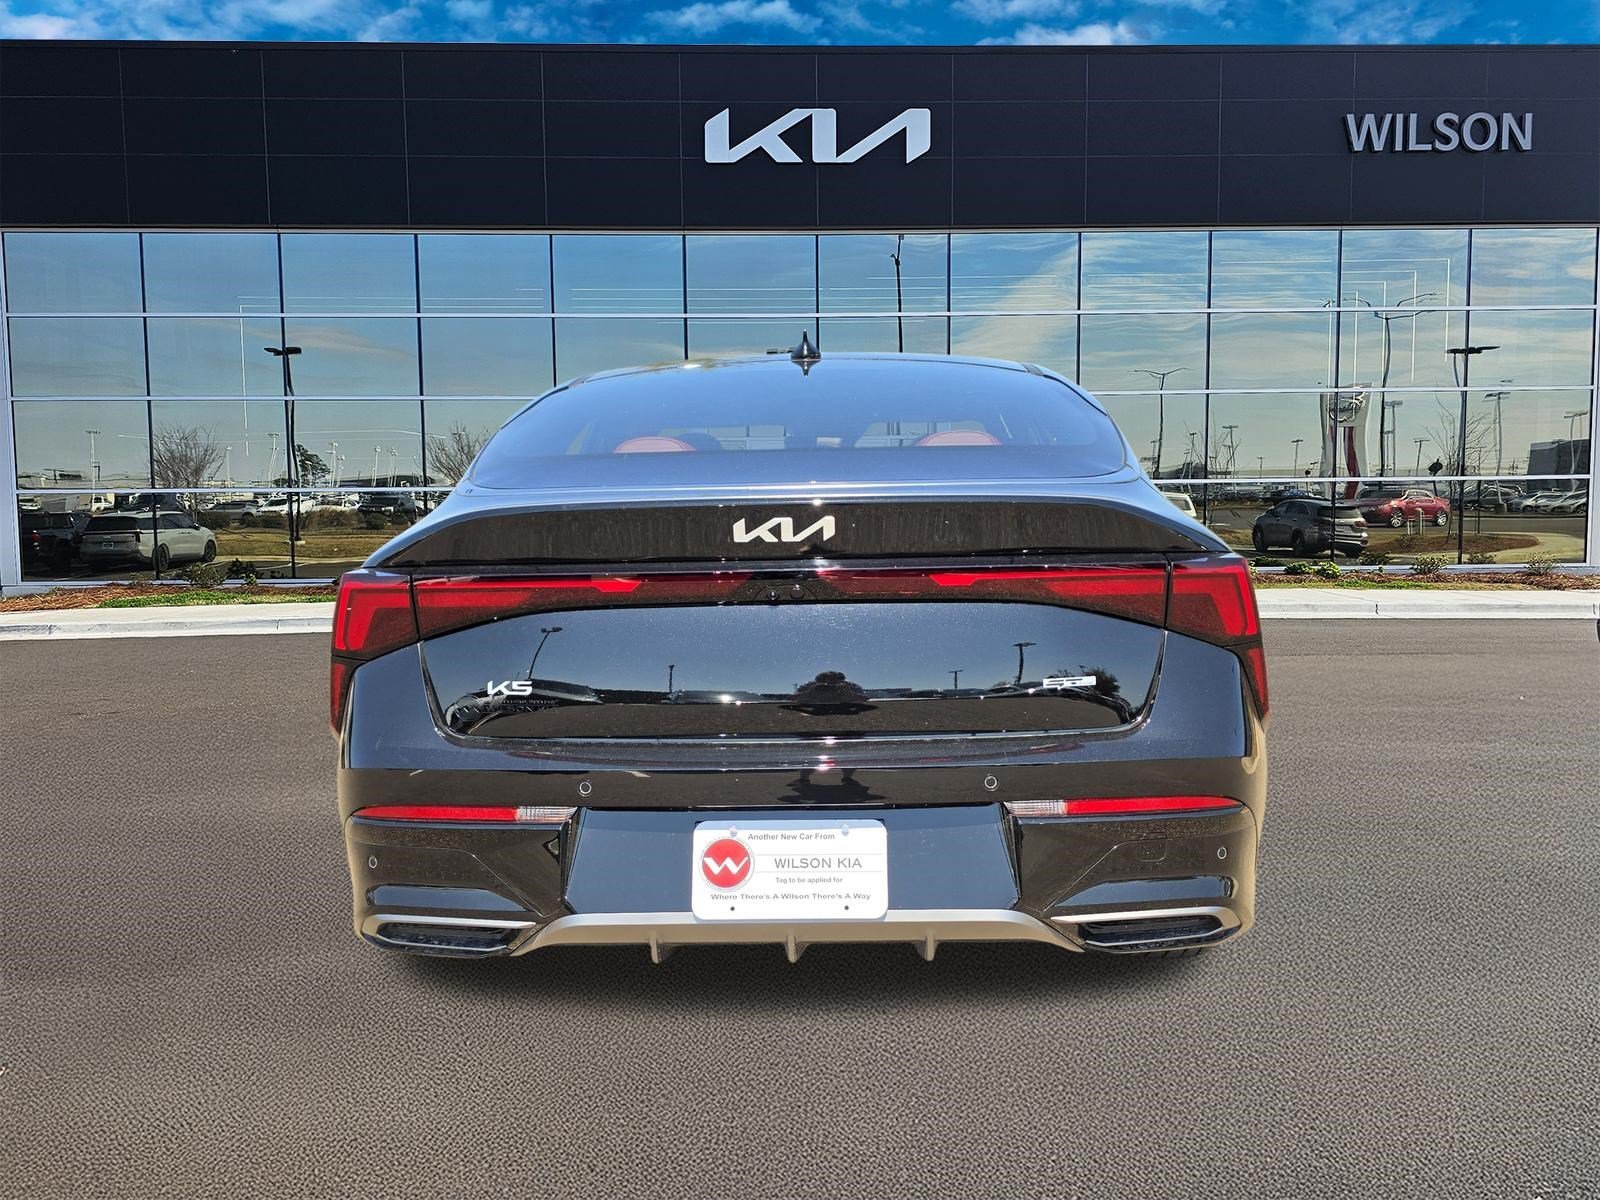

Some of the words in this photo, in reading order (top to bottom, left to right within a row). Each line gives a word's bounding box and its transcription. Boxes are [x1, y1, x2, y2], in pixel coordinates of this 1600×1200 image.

[704, 107, 931, 164] KIA
[1345, 111, 1534, 152] WILSON
[732, 515, 836, 543] KIA
[486, 680, 533, 696] K5
[748, 833, 778, 841] Another
[799, 832, 813, 840] Car
[814, 832, 835, 840] From
[774, 857, 832, 869] WILSON
[837, 857, 863, 869] KIA
